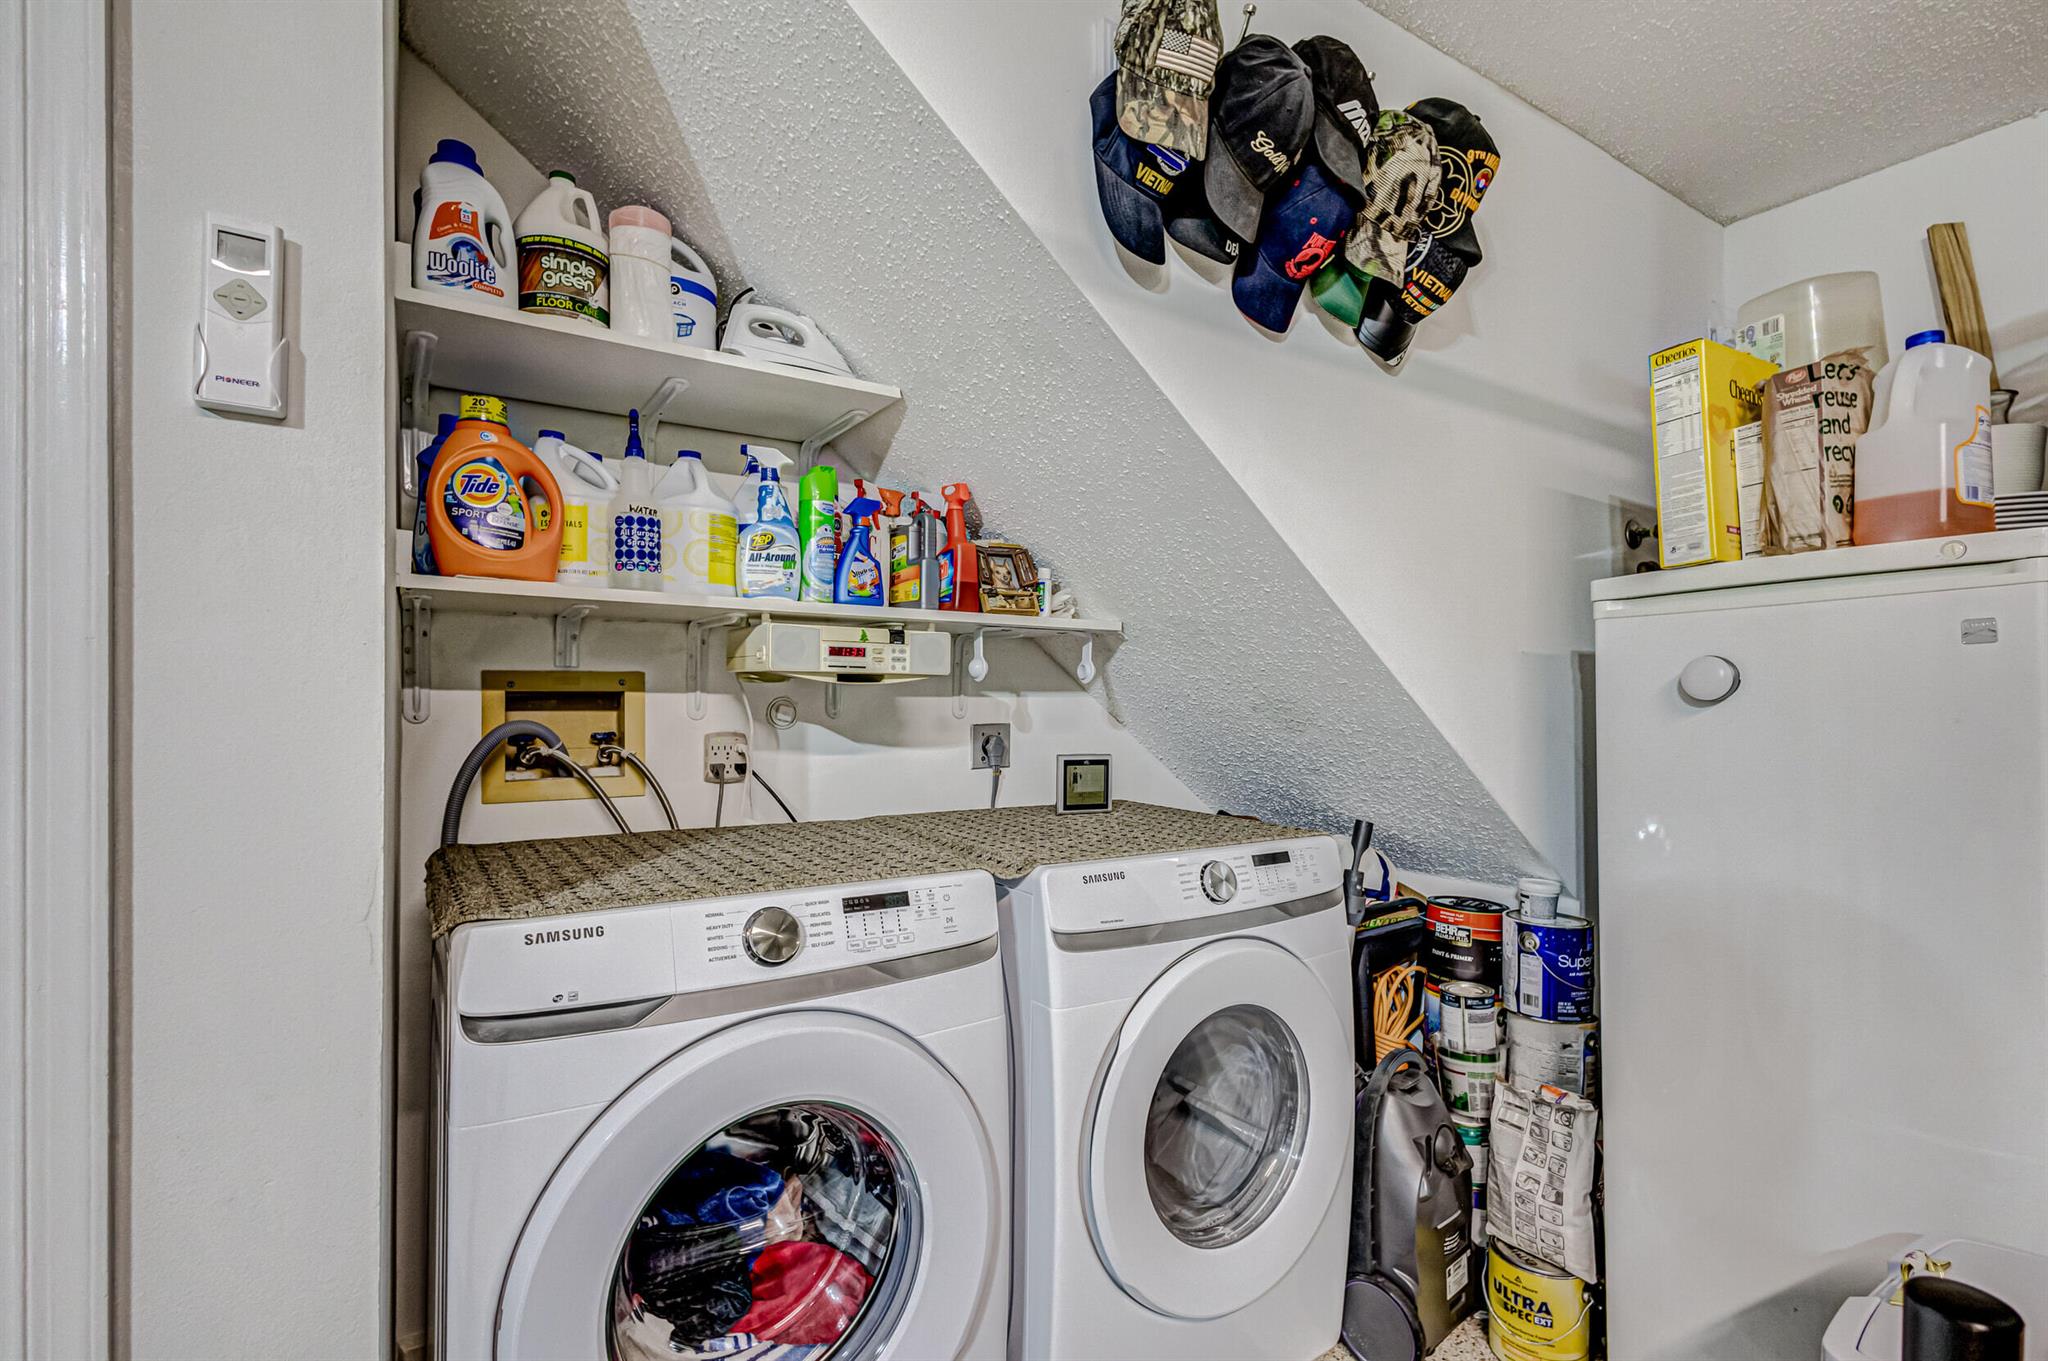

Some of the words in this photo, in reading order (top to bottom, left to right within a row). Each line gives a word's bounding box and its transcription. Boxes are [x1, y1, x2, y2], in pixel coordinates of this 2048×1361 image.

[1467, 149, 1487, 164] 9TH
[427, 250, 496, 285] Woolite
[541, 252, 596, 279] simple
[542, 270, 595, 295] green
[536, 297, 573, 310] FLOOR
[575, 303, 599, 318] CARE
[1655, 346, 1697, 367] Cheerios
[215, 375, 261, 388] PIONEER
[1776, 383, 1817, 401] Shredded
[1782, 394, 1811, 407] Wheat
[1812, 391, 1858, 408] reuse
[1818, 412, 1851, 435] and
[460, 474, 501, 495] Tide
[451, 507, 487, 519] SPORT
[629, 504, 658, 517] WATER
[620, 528, 630, 536] All
[748, 552, 796, 562] All-Around
[1082, 871, 1126, 885] SAMSUNG
[524, 925, 605, 946] SAMSUNG
[1435, 922, 1459, 936] BEHR
[1493, 1277, 1553, 1318] ULTRA
[1503, 1300, 1532, 1324] SPEC
[1534, 1315, 1553, 1328] EXT
